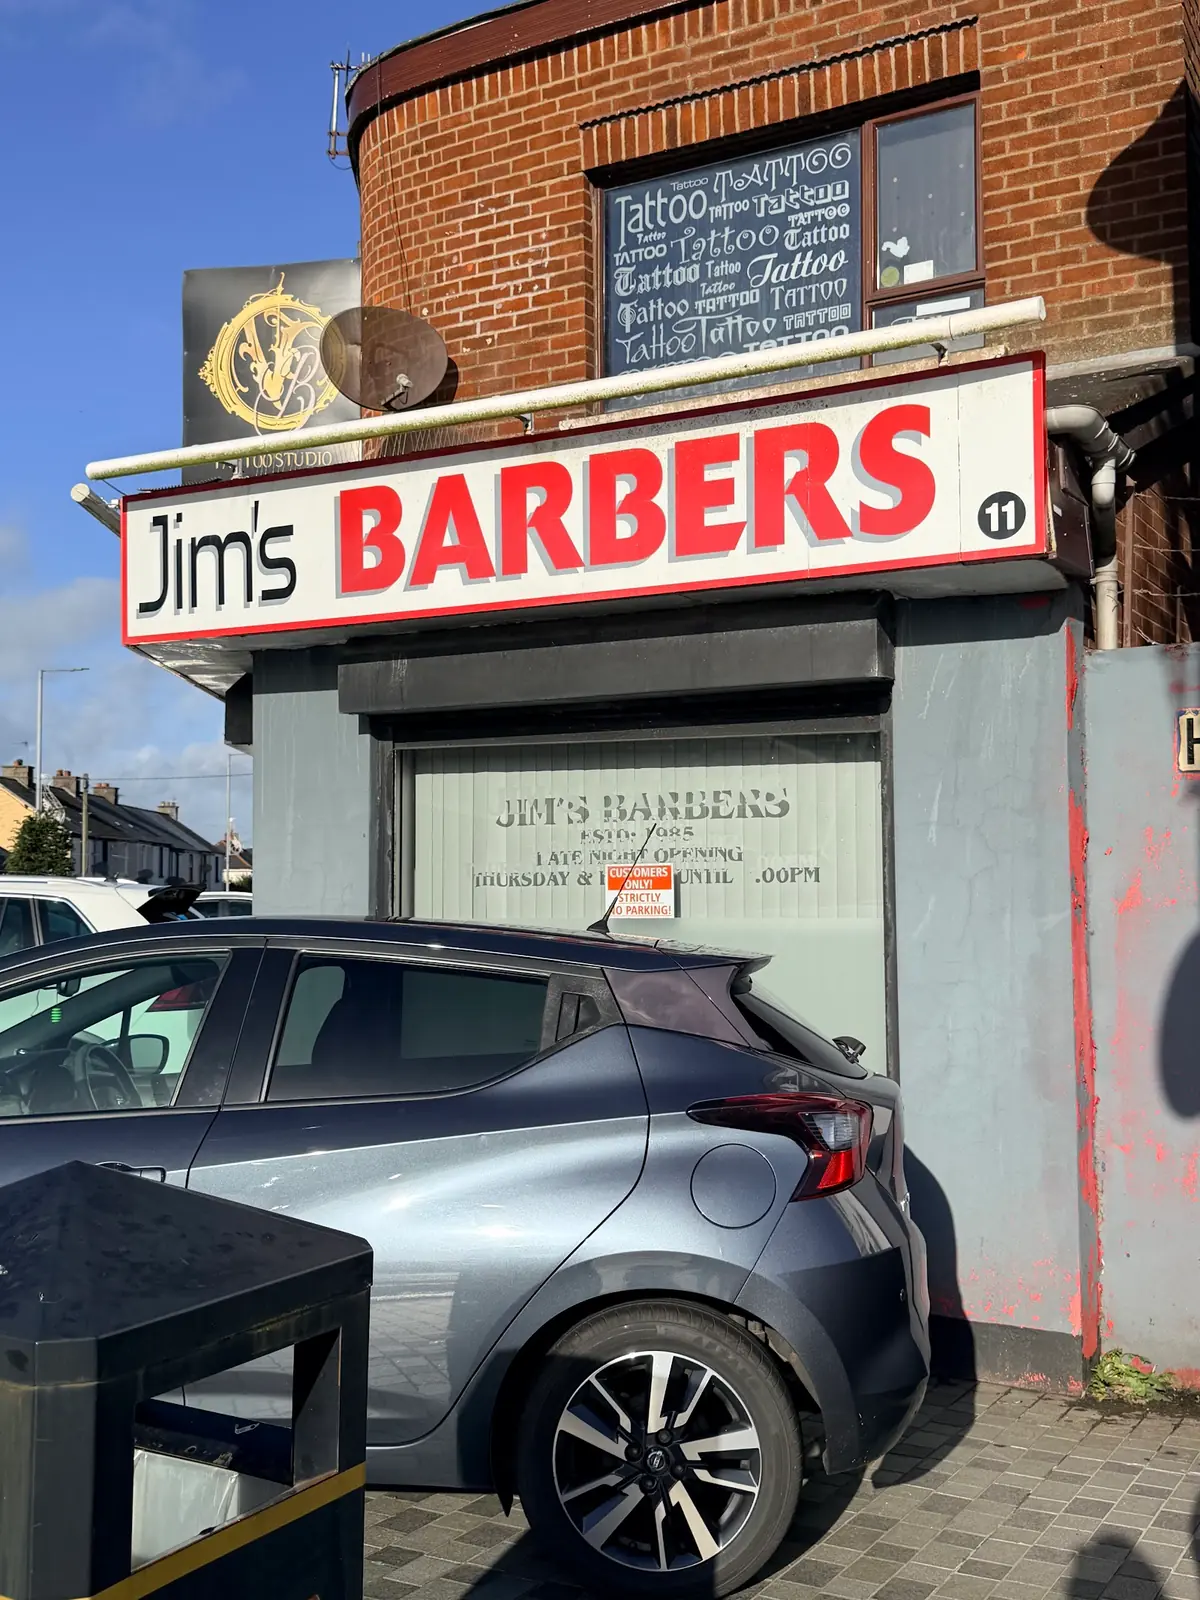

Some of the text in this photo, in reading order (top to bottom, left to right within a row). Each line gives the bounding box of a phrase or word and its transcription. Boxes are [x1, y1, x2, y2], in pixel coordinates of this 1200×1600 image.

[670, 177, 709, 191] Tattoo
[713, 142, 851, 202] TATTOO
[752, 179, 849, 217] Tattoo
[614, 187, 707, 251] Tattoo
[788, 203, 850, 228] TATTOO
[670, 226, 779, 264] Tattoo
[784, 223, 849, 250] Tattoo
[614, 243, 667, 266] TATTOO
[613, 262, 700, 296] Tattoo
[705, 259, 741, 279] Tattoo
[746, 249, 848, 288] Tattoo
[694, 288, 760, 314] TATTOO
[700, 281, 735, 298] Tattoo
[617, 298, 689, 334] Tattoo
[782, 302, 851, 331] TATTOO
[615, 323, 696, 364] Tattoo
[672, 308, 777, 353] Tattoo
[275, 451, 332, 468] STUDIO
[136, 403, 937, 619] Jim's BARBERS
[985, 500, 1015, 532] 11
[577, 871, 593, 886] &
[609, 867, 668, 878] CUSTOMERS
[624, 879, 653, 889] ONLY!
[618, 893, 661, 902] STRICTLY
[626, 905, 672, 915] PARKING!
